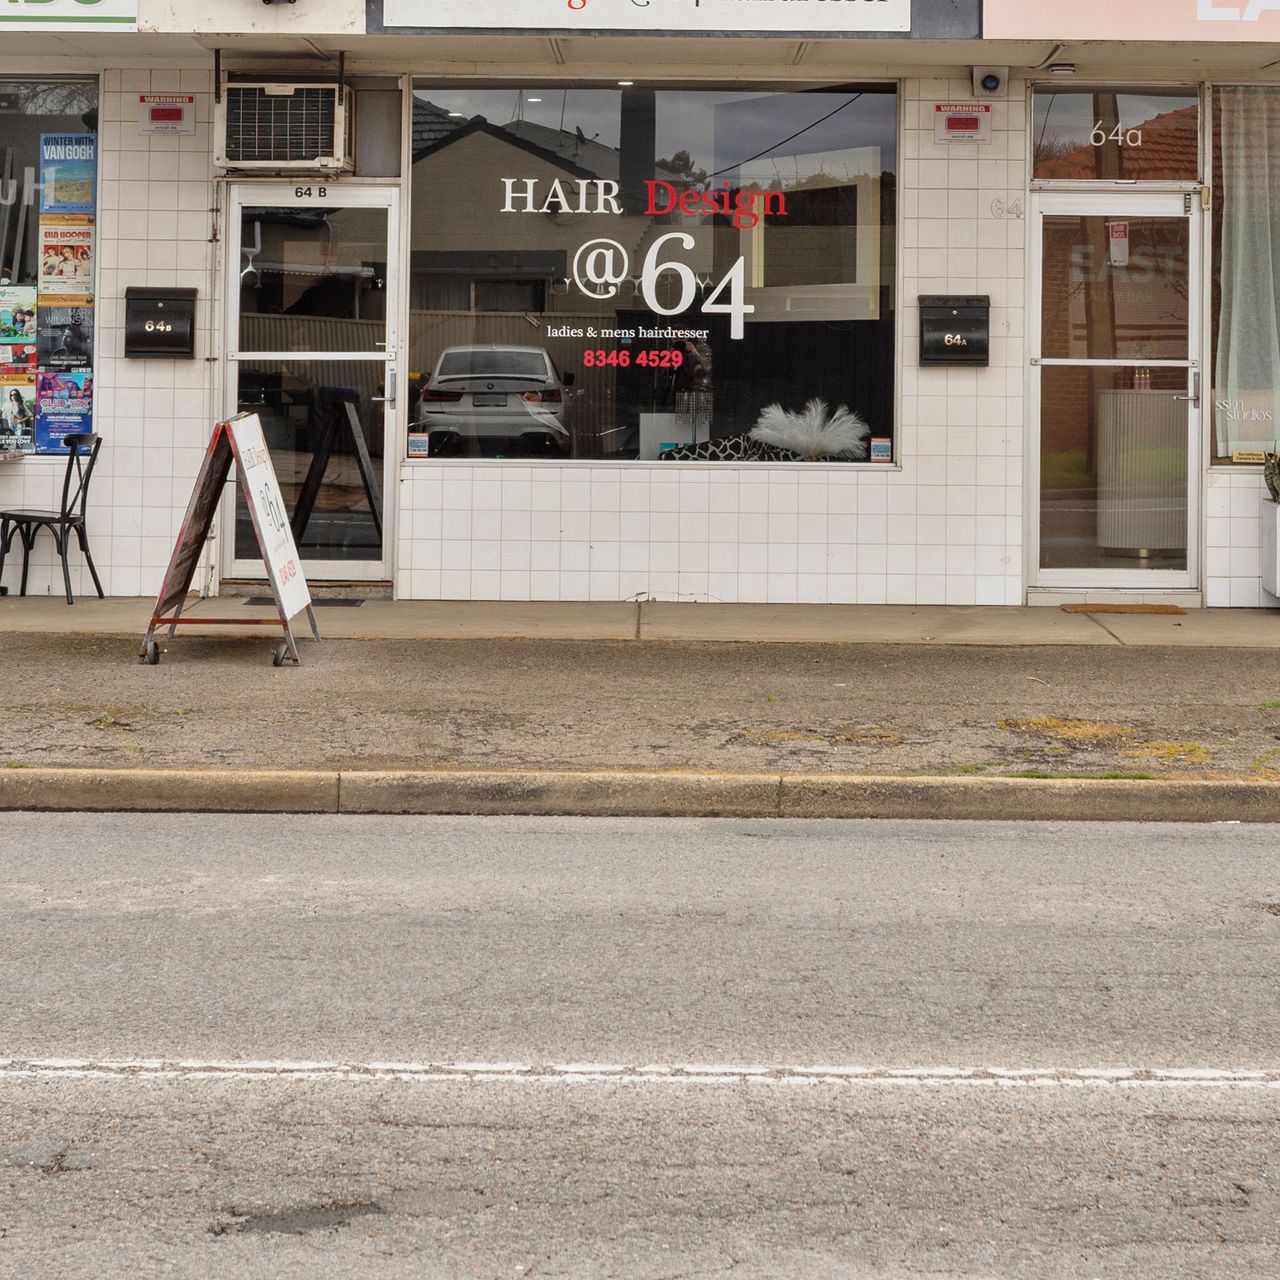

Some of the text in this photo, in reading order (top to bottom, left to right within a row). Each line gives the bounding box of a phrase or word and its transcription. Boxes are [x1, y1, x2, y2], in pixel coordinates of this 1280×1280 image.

[43, 136, 94, 146] WINTER WITH
[1089, 120, 1143, 147] 64a
[43, 145, 94, 160] VAN GOGH
[294, 186, 327, 198] 64 B
[500, 178, 789, 230] HAIR Design
[990, 196, 1024, 219] 64
[572, 232, 755, 340] @ 64
[546, 325, 709, 339] ladies & mens hairdresser
[583, 349, 684, 368] 8346 4529
